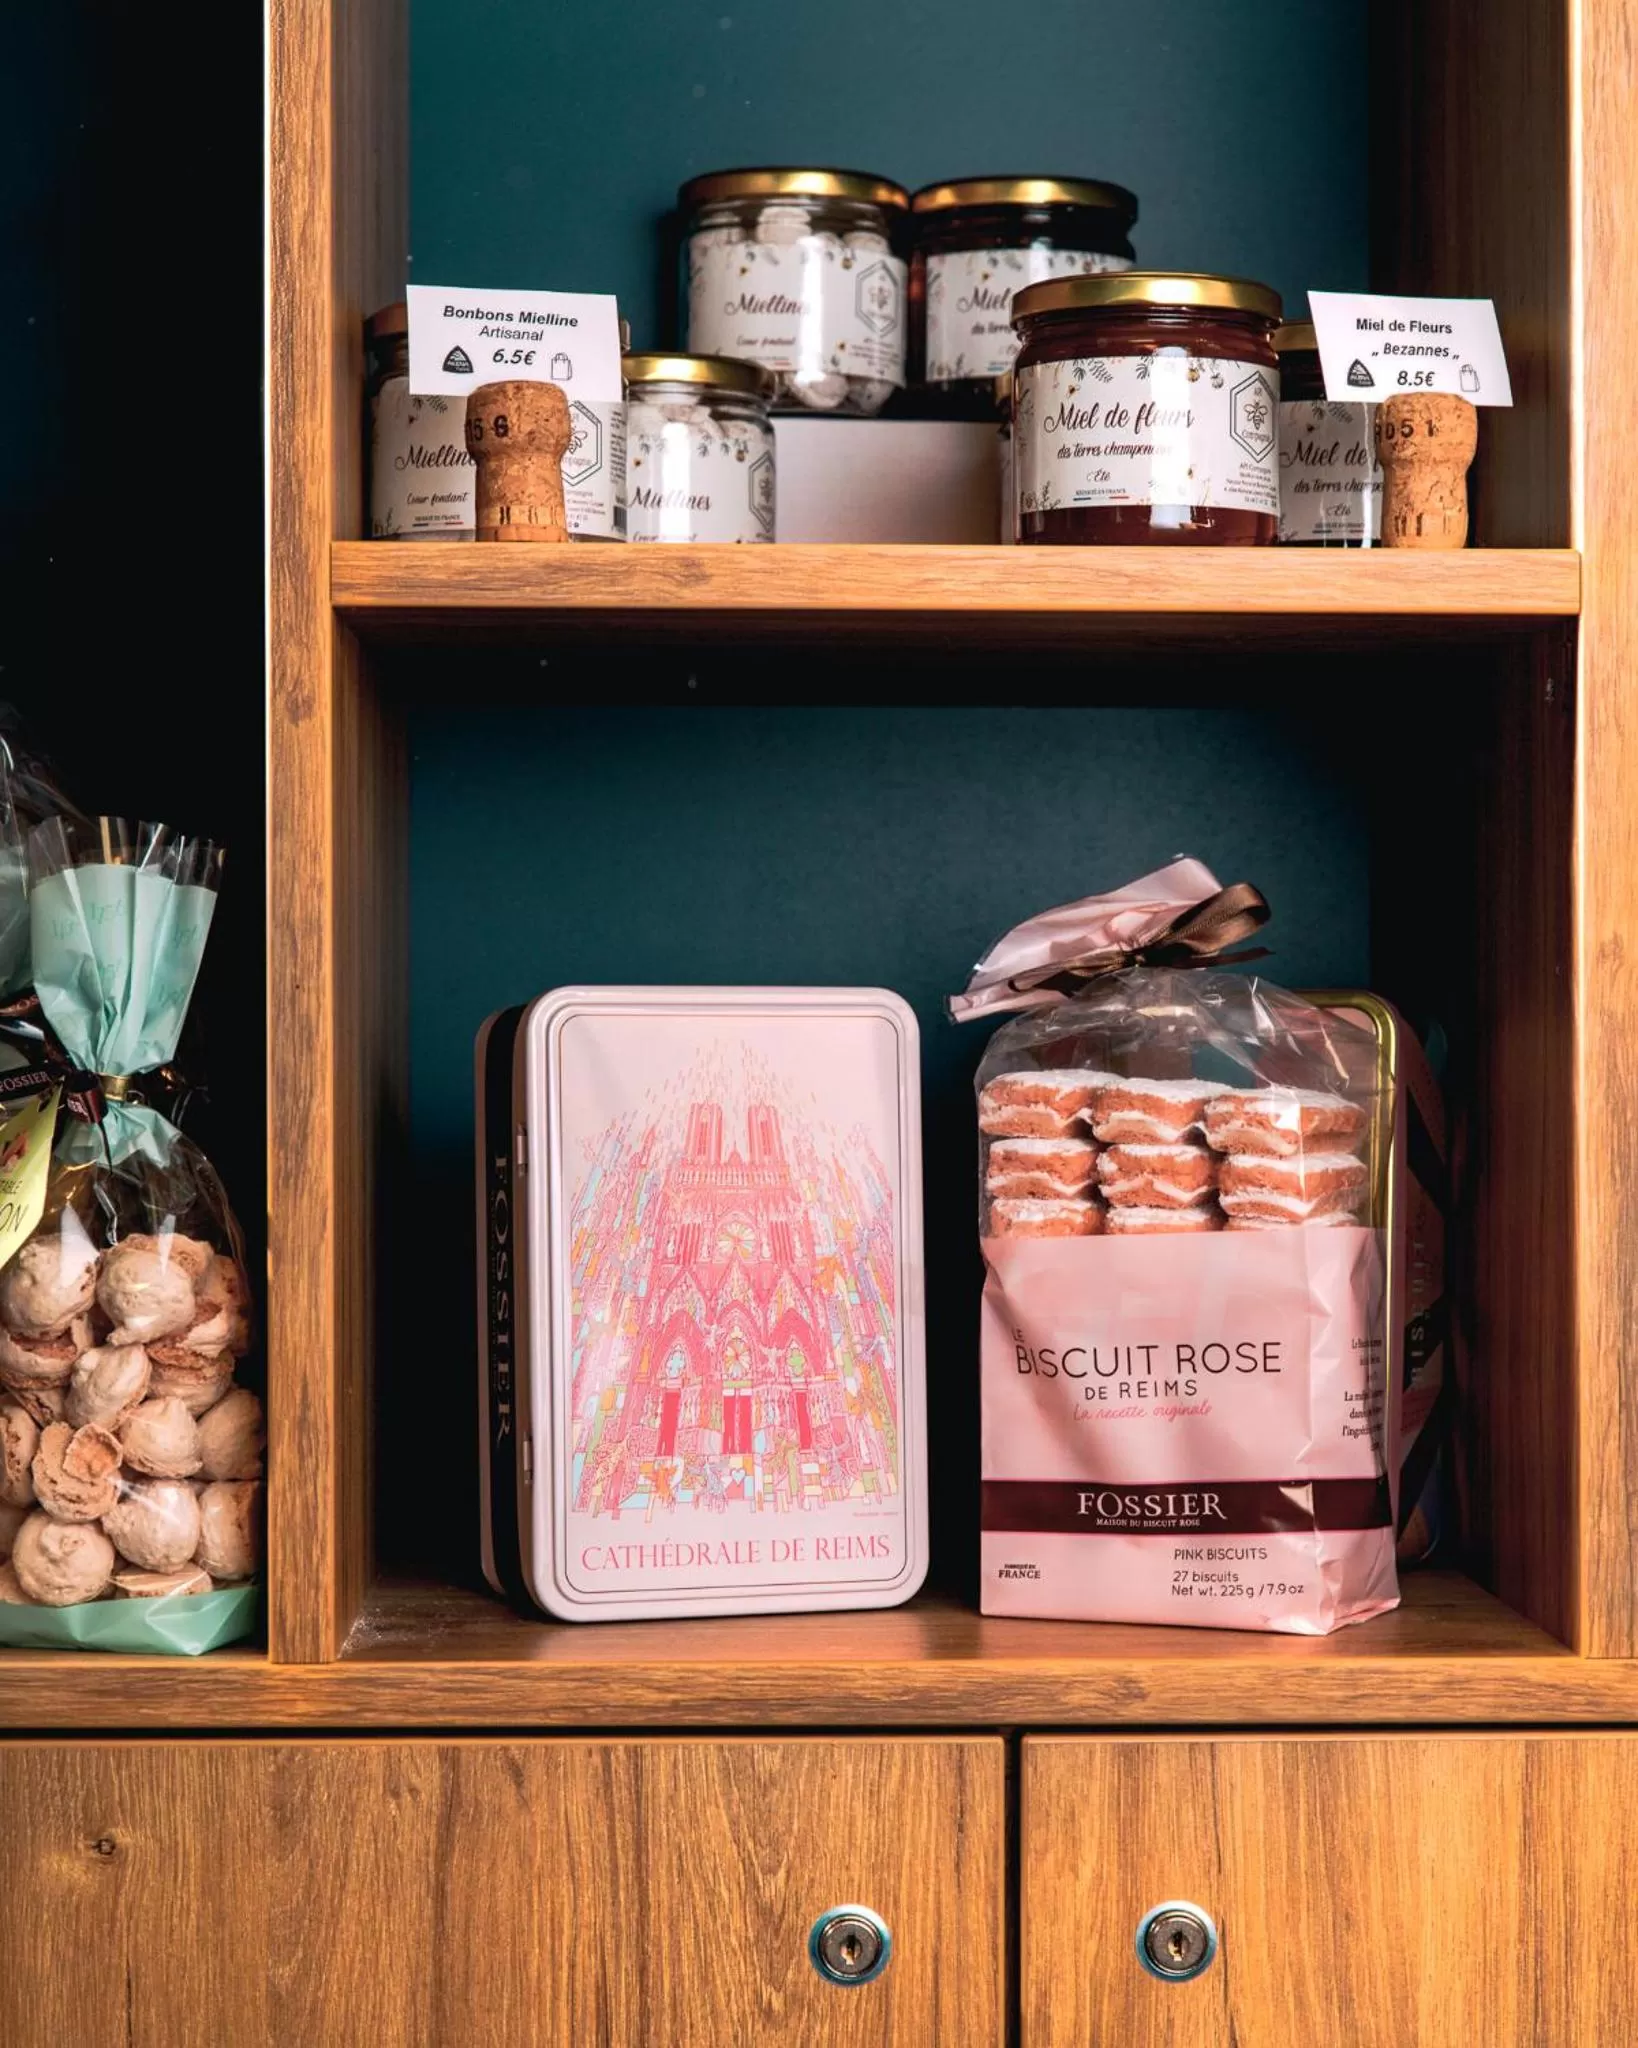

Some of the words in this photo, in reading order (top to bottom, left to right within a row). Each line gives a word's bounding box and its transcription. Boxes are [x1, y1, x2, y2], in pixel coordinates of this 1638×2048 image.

[443, 305, 514, 323] Bonbons
[519, 311, 579, 327] Mielline
[478, 325, 544, 341] Artisanal
[1356, 318, 1384, 331] Miel
[1388, 320, 1406, 332] de
[1409, 320, 1453, 334] Fleurs
[492, 348, 536, 366] 6.5€
[1383, 342, 1449, 357] Bezannes
[1397, 370, 1436, 387] 8.5€
[1043, 402, 1100, 433] Miel
[1103, 402, 1130, 429] de
[1134, 401, 1196, 435] fleurs
[1057, 443, 1071, 459] des
[1073, 442, 1101, 458] terres
[1280, 440, 1339, 468] Miel
[1344, 441, 1367, 467] de
[1312, 478, 1341, 493] terres
[1011, 1328, 1024, 1343] LE
[1016, 1345, 1159, 1379] BISCUIT
[1175, 1341, 1282, 1375] ROSE
[1084, 1386, 1108, 1401] DE
[1119, 1379, 1198, 1399] REIMS
[1073, 1403, 1092, 1421] La
[1096, 1405, 1147, 1420] recette
[1152, 1399, 1213, 1423] originale
[1077, 1491, 1228, 1520] FOSSIER
[1143, 1519, 1177, 1528] BISCUIT
[582, 1537, 760, 1571] CATHÉDRALE
[771, 1537, 807, 1563] DE
[815, 1533, 890, 1561] REIMS
[1174, 1548, 1204, 1560] PINK
[1207, 1547, 1268, 1560] BISCUITS
[998, 1569, 1041, 1579] FRANCE
[1173, 1570, 1189, 1582] 27
[1192, 1570, 1239, 1582] biscuits
[1171, 1584, 1193, 1596] Net
[1197, 1585, 1217, 1597] wt.
